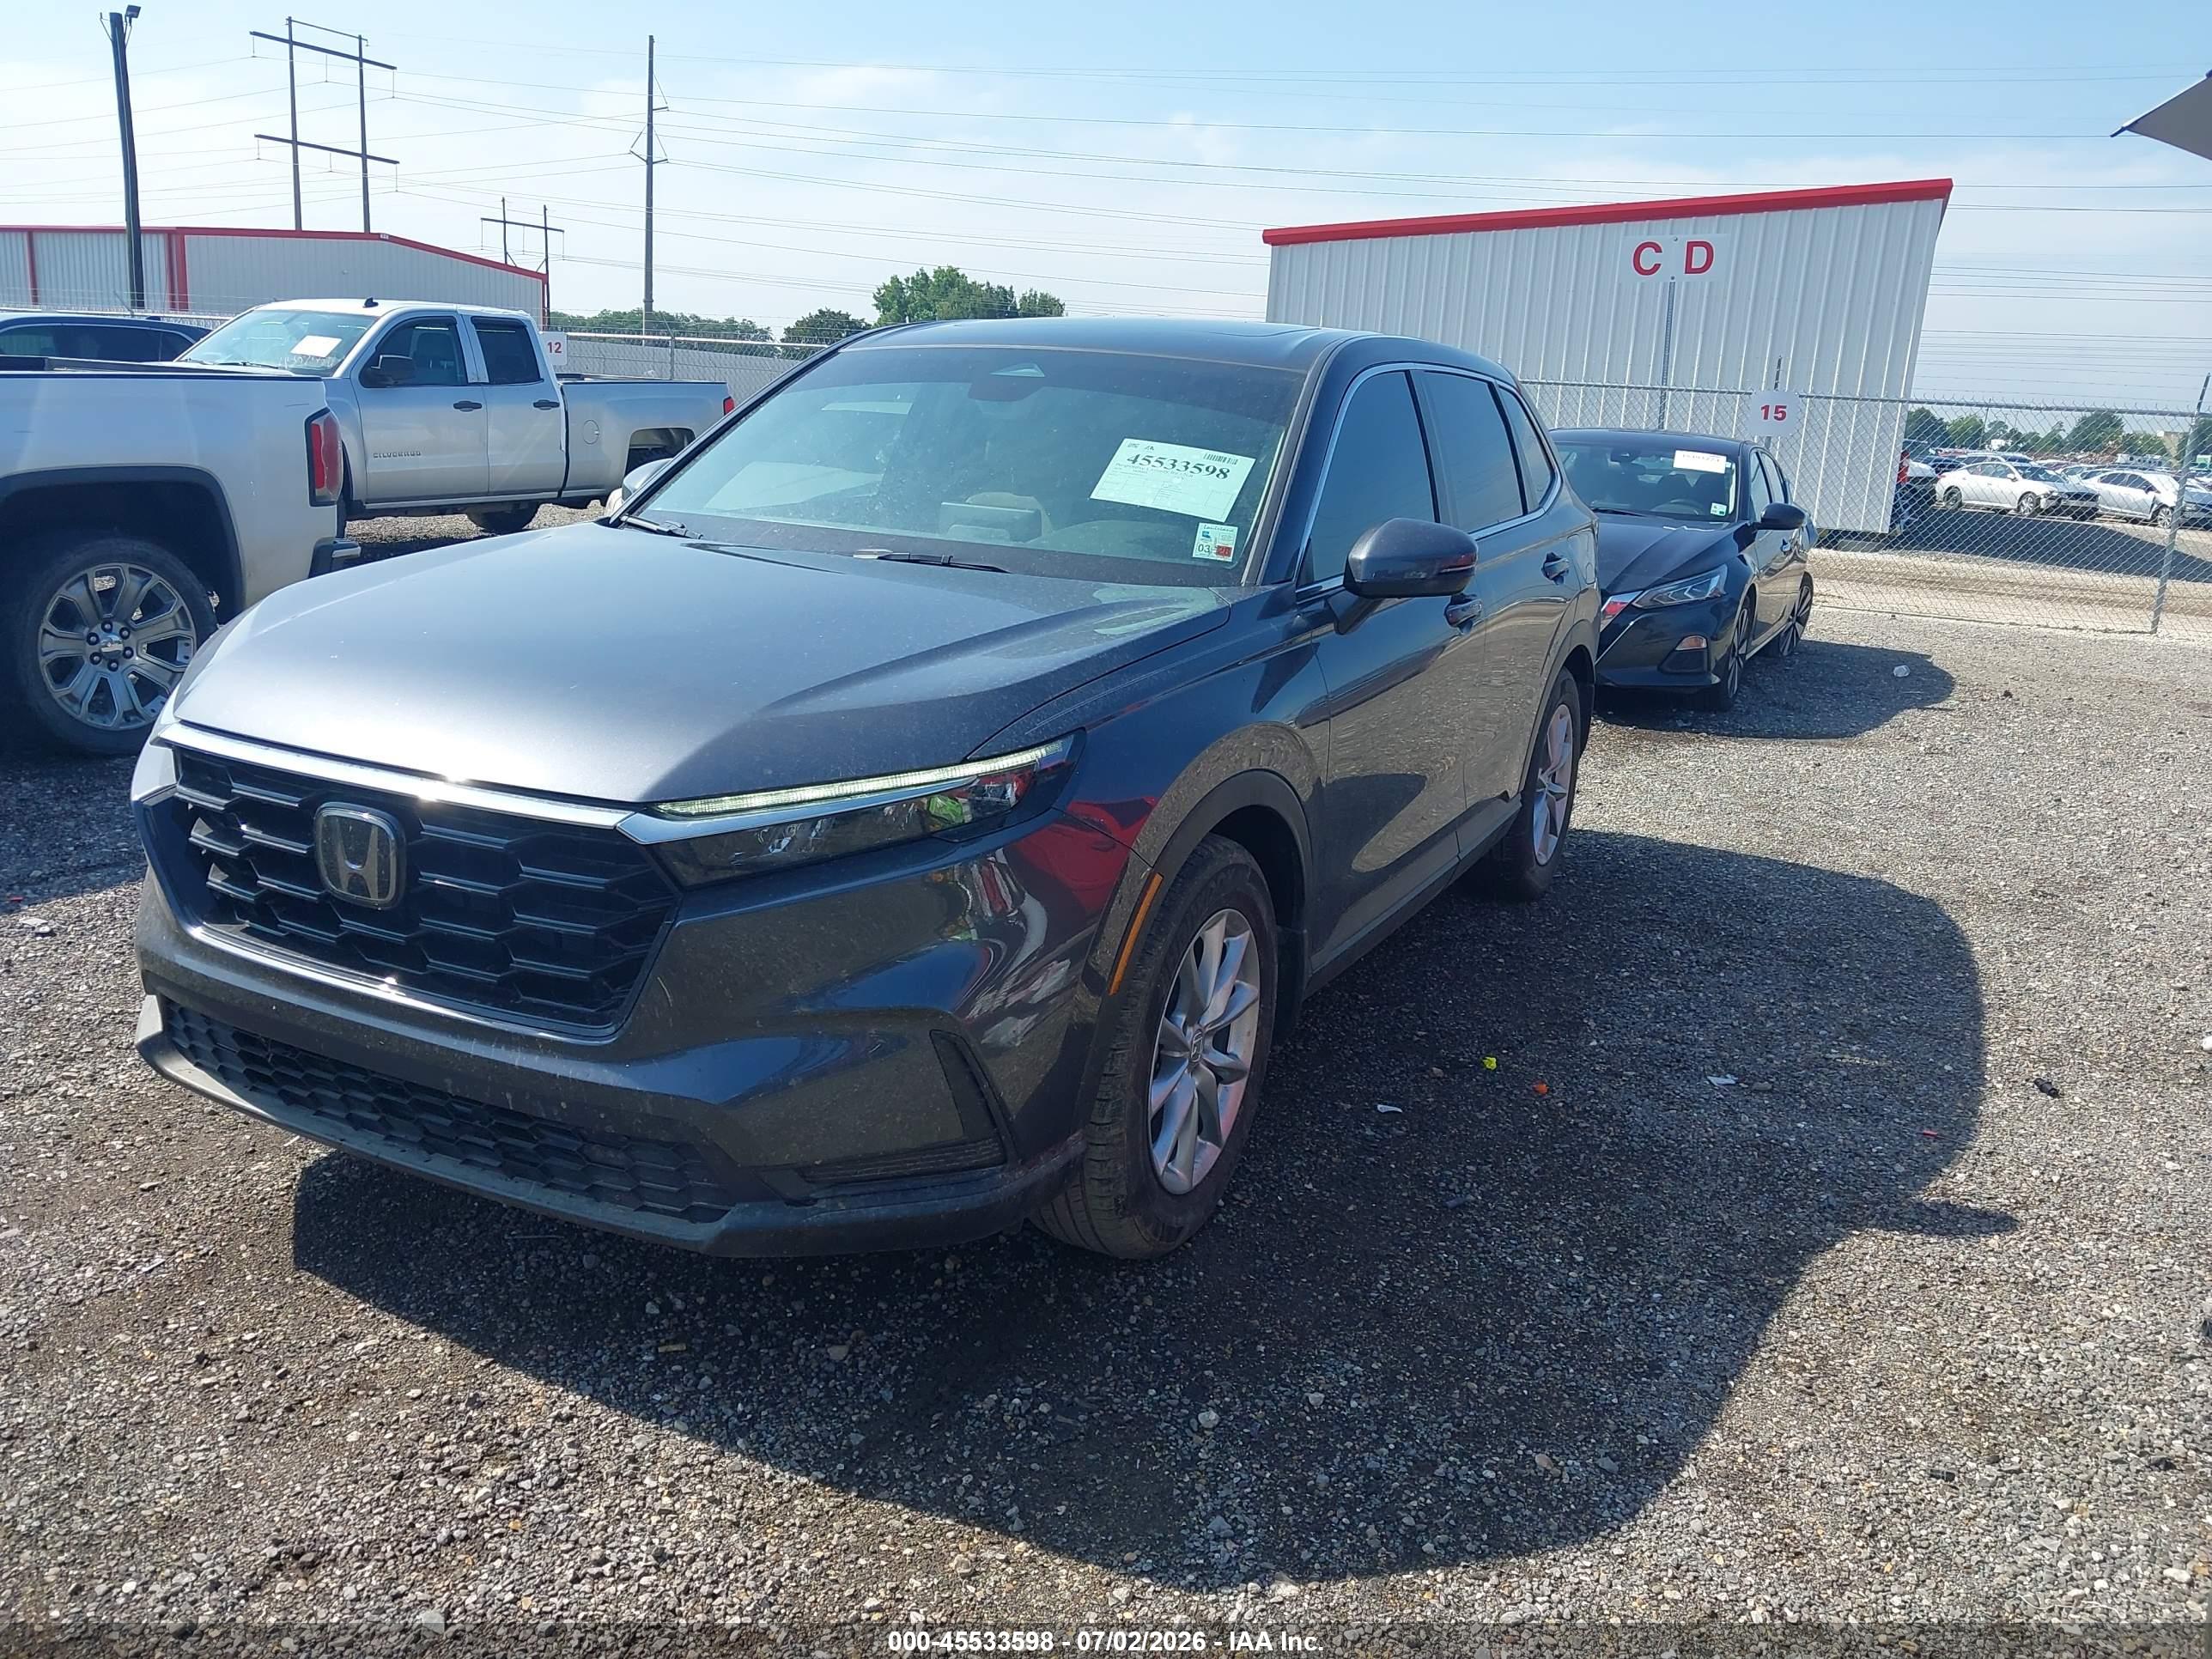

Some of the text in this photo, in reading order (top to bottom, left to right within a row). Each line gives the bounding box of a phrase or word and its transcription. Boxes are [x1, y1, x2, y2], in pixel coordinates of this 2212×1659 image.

[1632, 240, 1714, 276] C D
[547, 342, 562, 354] 12
[1760, 404, 1787, 421] 15
[1127, 453, 1231, 480] 45533598
[1197, 544, 1211, 554] 03
